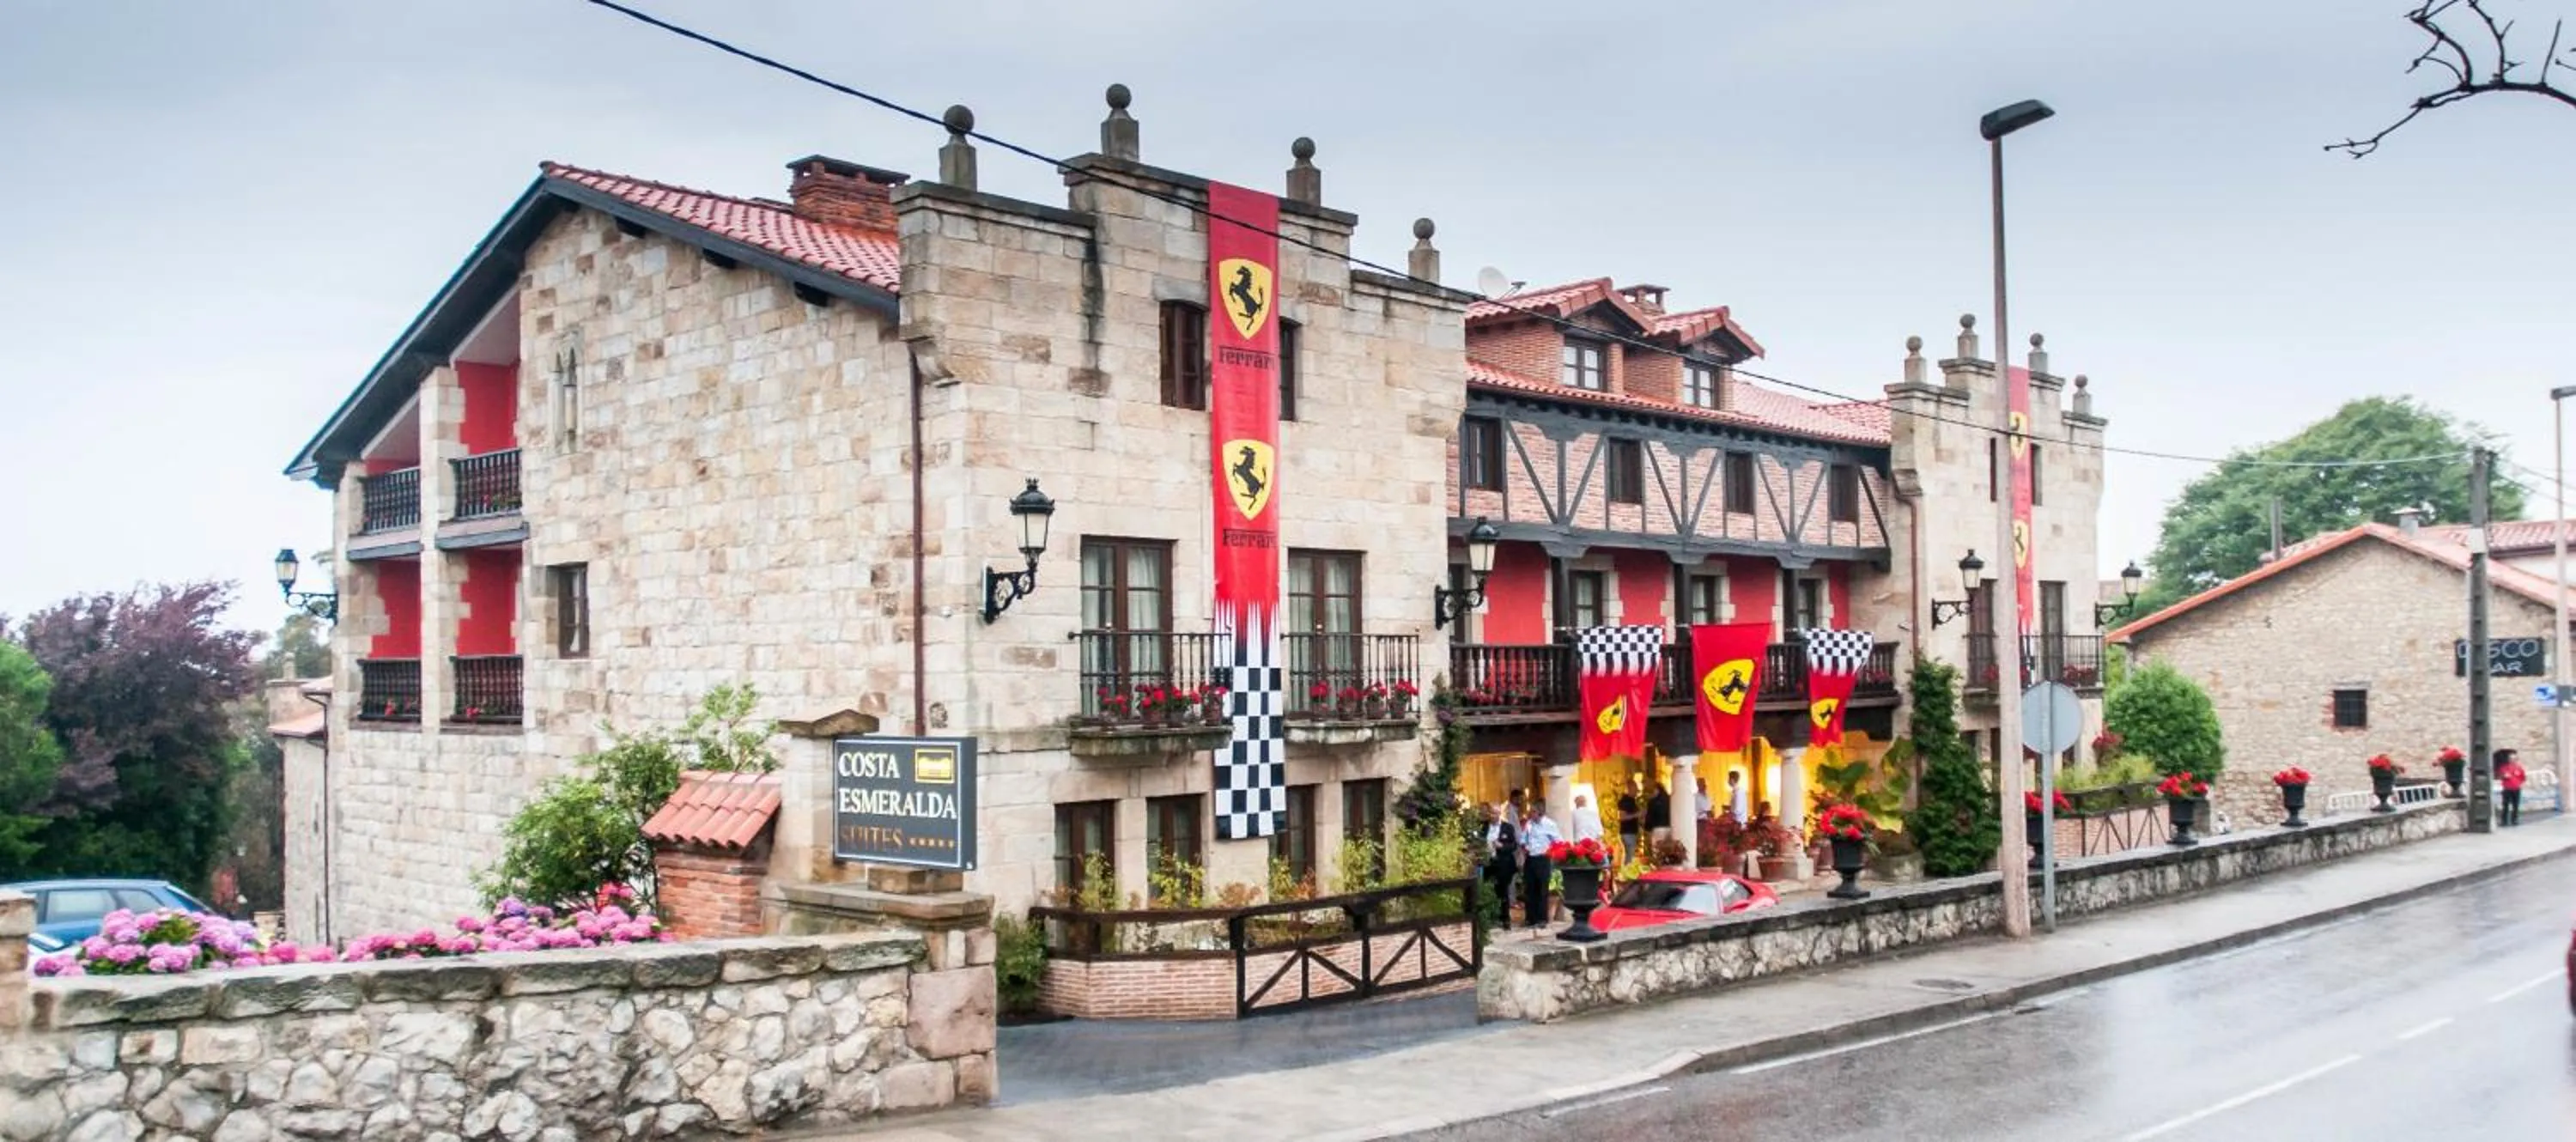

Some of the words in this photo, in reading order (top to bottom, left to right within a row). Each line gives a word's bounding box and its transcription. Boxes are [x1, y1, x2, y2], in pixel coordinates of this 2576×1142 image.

[1223, 528, 1276, 549] Ferrar
[2458, 639, 2538, 659] SCO
[2489, 660, 2523, 673] AR
[838, 752, 901, 778] COSTA
[839, 787, 957, 819] ESMERALDA
[840, 824, 903, 850] SUITES
